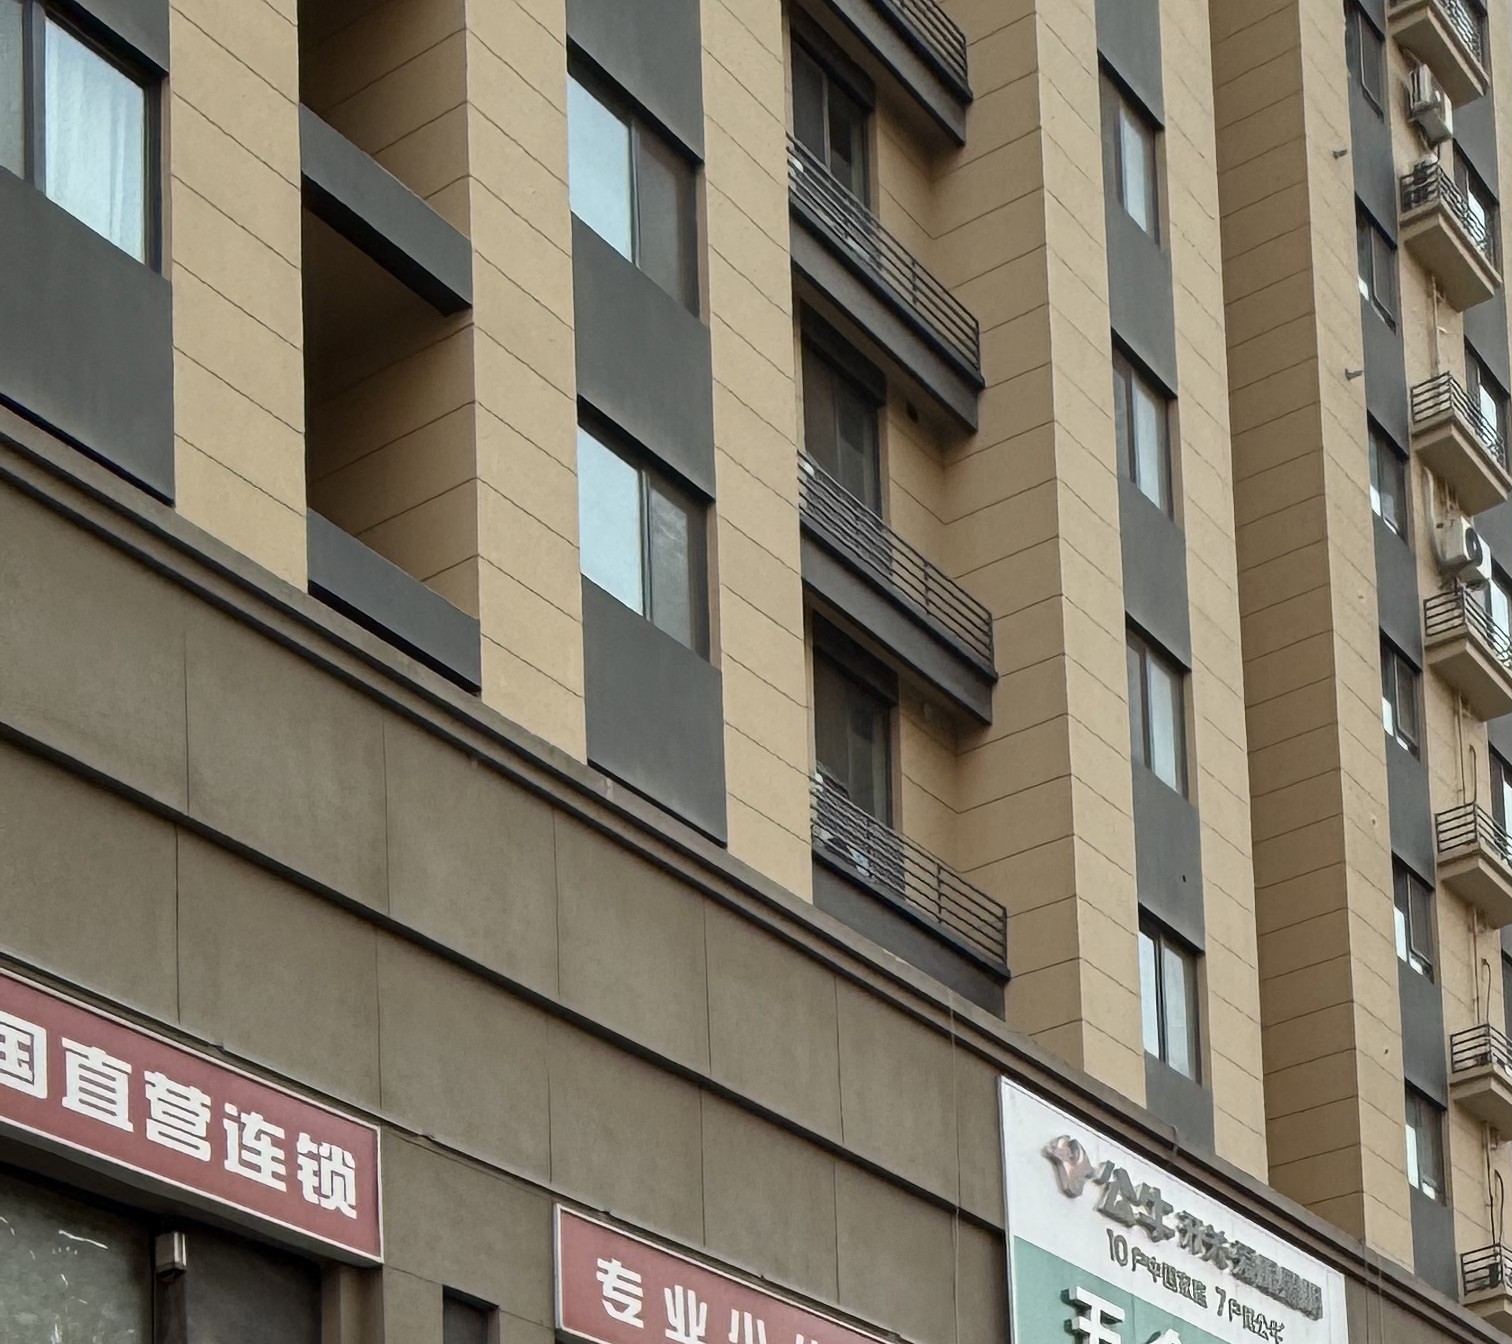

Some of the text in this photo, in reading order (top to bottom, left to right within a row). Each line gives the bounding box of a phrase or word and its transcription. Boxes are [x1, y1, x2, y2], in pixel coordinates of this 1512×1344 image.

[0, 1012, 357, 1219] 国直营连锁
